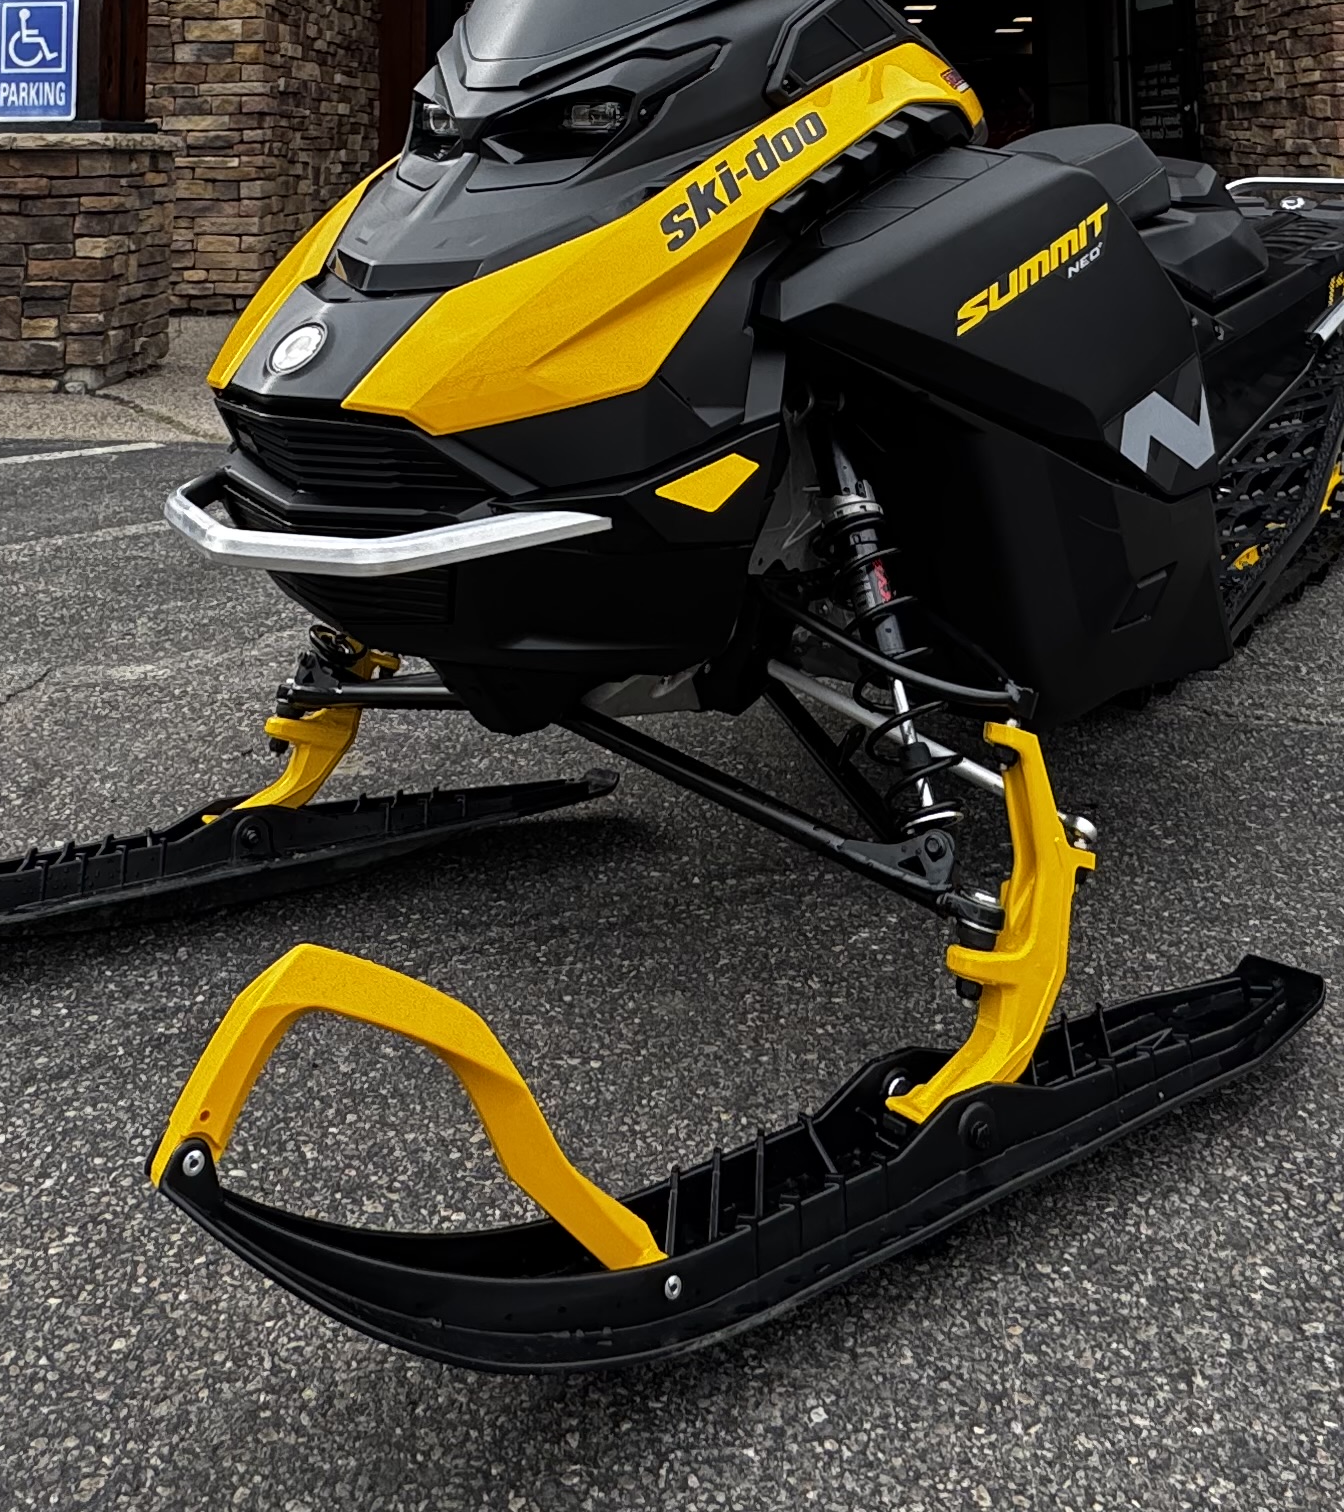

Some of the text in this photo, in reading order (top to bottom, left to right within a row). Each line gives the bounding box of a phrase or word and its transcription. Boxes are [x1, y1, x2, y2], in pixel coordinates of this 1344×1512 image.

[0, 81, 66, 107] PARKING
[660, 111, 828, 252] ski-doo
[957, 202, 1109, 336] SUMMIT
